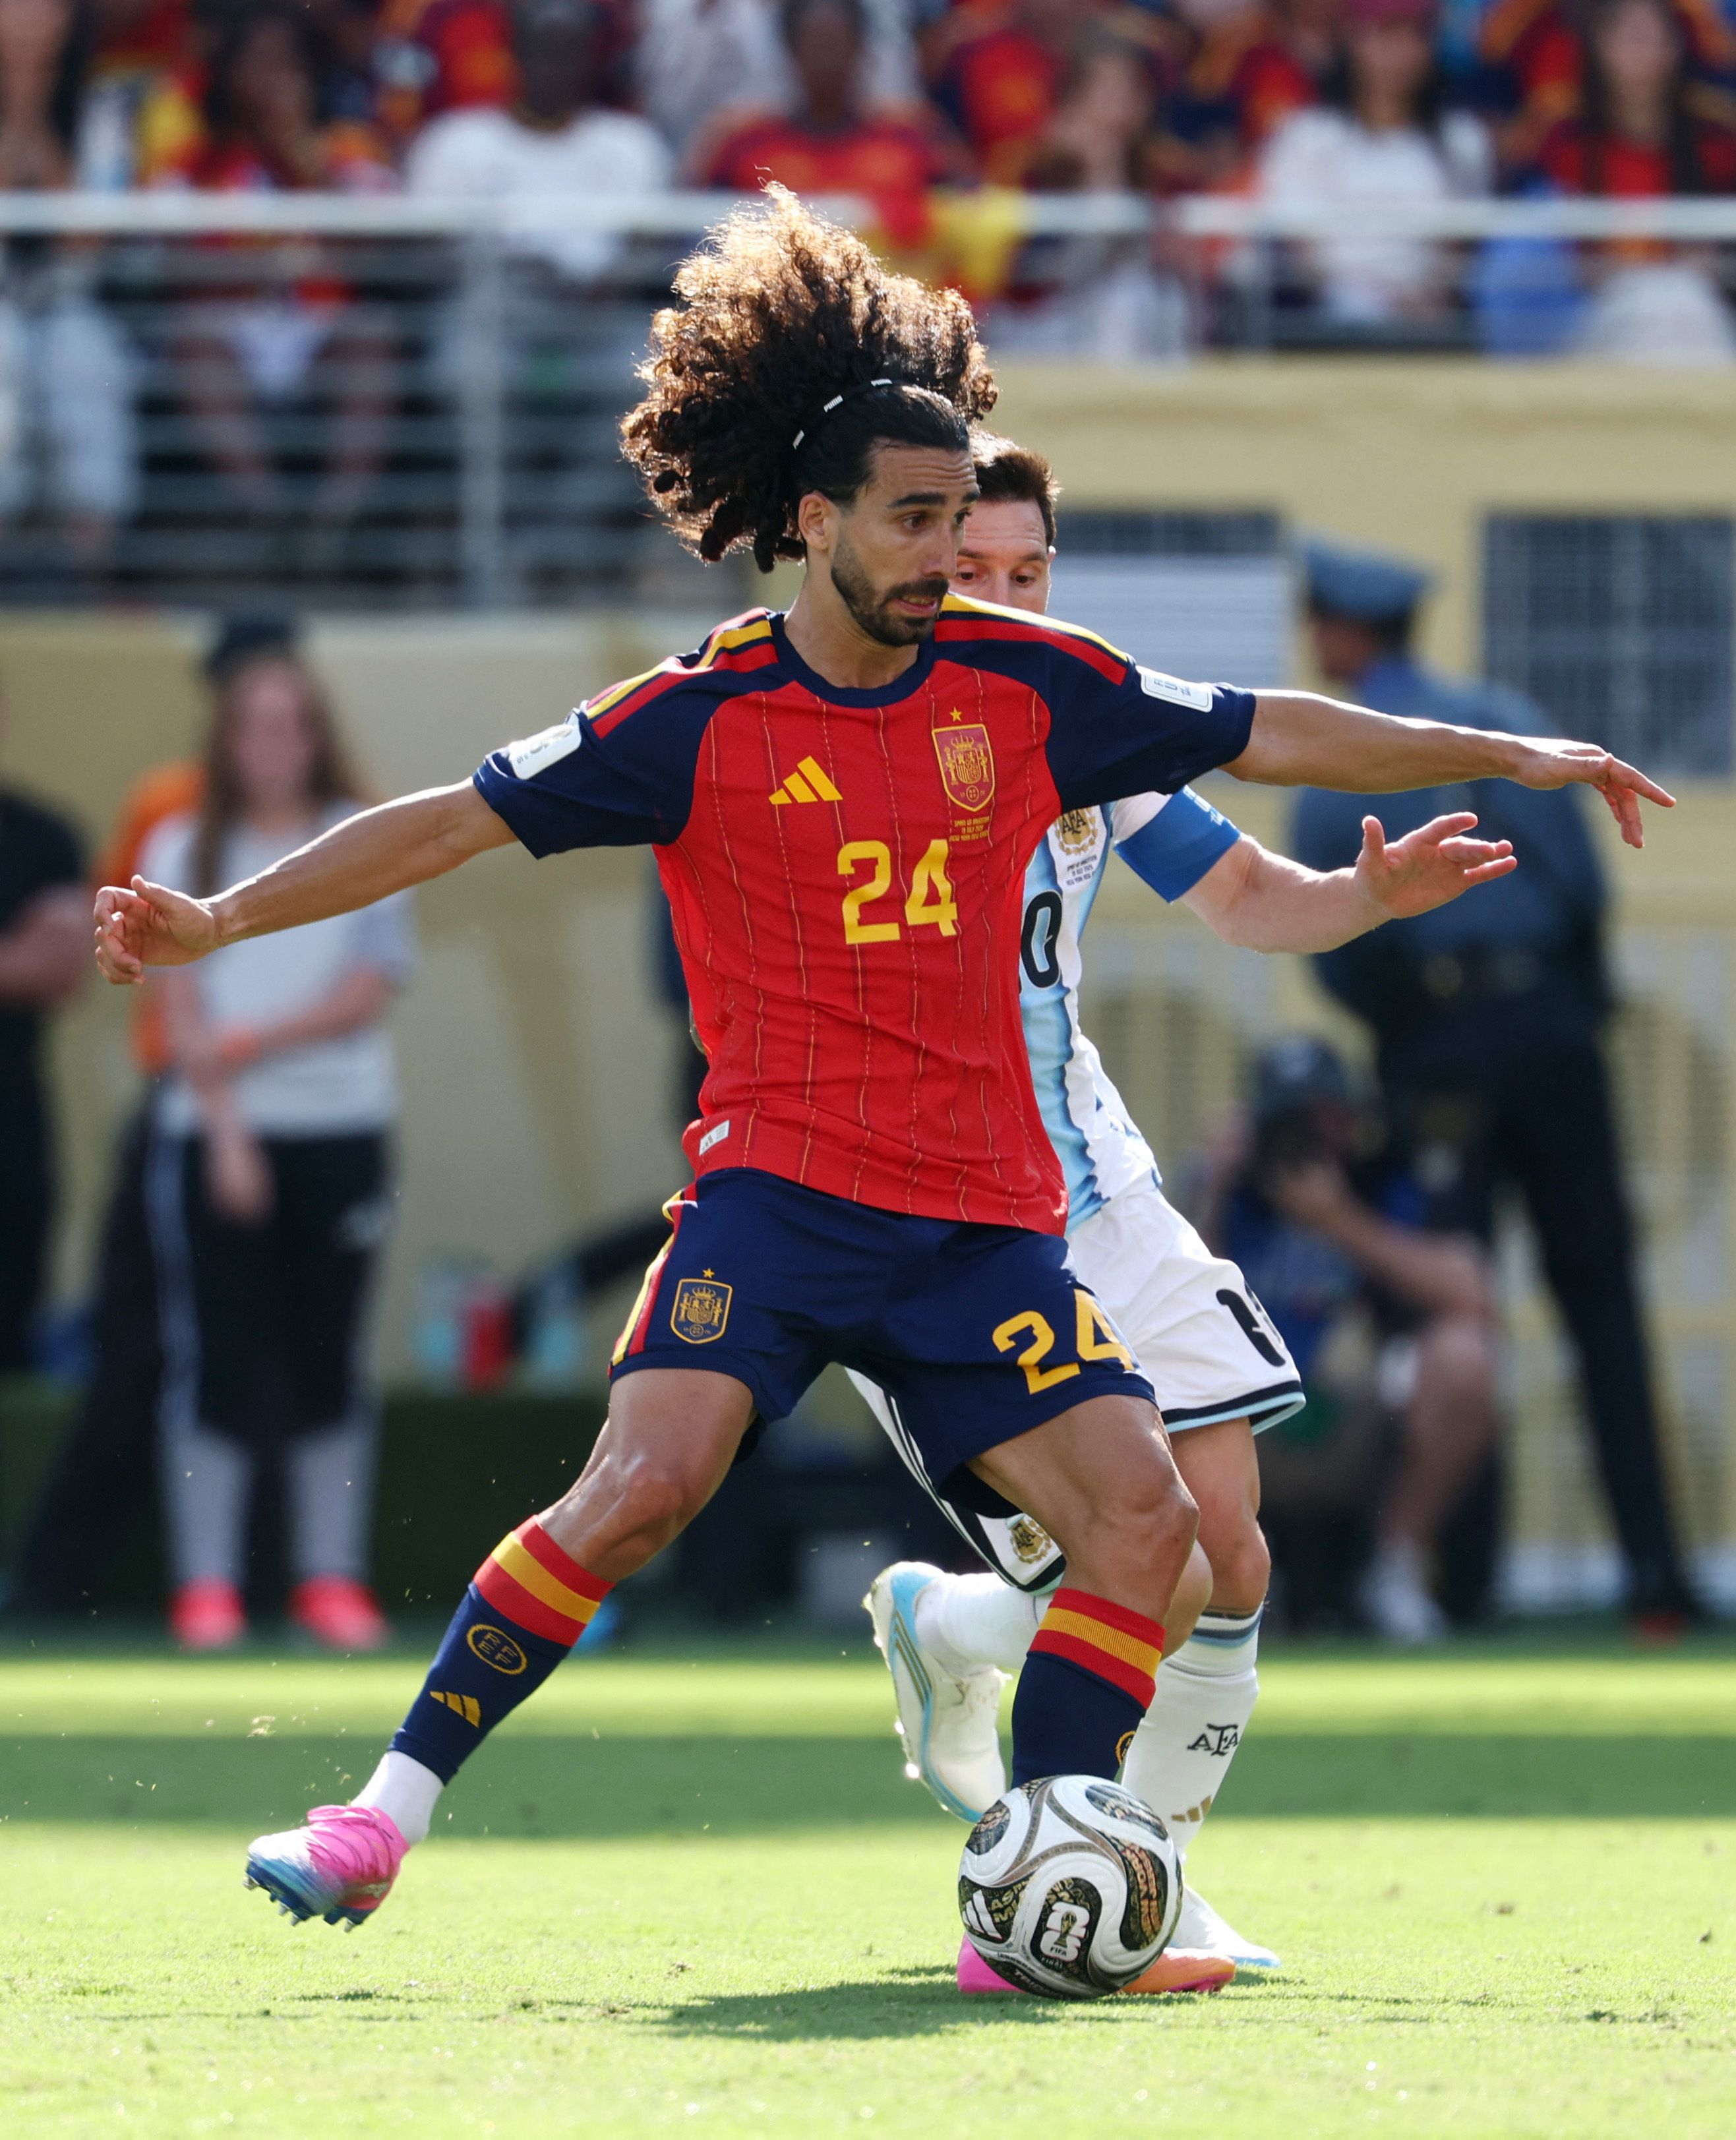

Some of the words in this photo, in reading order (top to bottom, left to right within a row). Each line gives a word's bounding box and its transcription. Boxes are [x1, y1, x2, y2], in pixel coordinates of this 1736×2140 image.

[837, 839, 958, 945] 24
[1018, 890, 1063, 994] 0
[992, 1288, 1134, 1395] 24
[1187, 1722, 1238, 1756] AFA
[1050, 1946, 1067, 1957] FIFA
